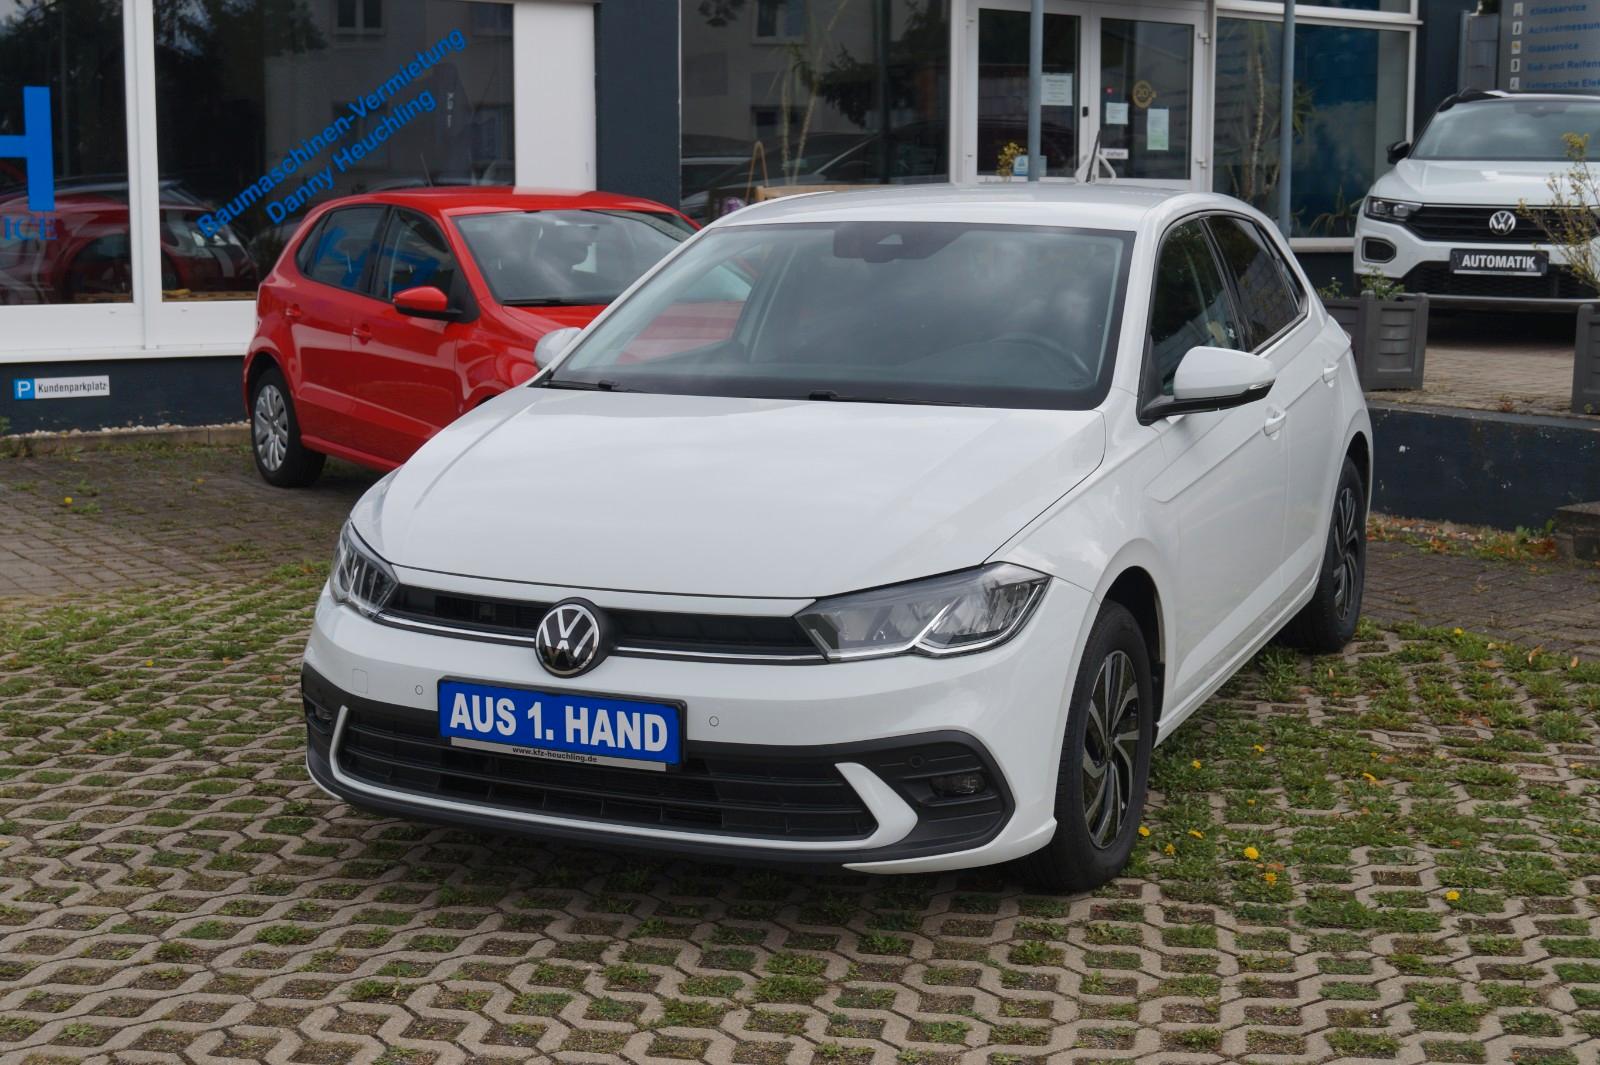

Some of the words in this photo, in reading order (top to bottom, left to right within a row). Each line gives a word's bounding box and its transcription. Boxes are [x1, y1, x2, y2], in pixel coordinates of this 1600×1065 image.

[1548, 62, 1565, 71] und
[195, 28, 467, 238] Baumaschinen-Vermietung
[265, 166, 336, 225] Danny
[332, 89, 437, 174] Heuchling
[1461, 253, 1536, 269] AUTOMATIK
[18, 381, 31, 398] P
[38, 381, 107, 393] Kundenparkplatz
[450, 692, 517, 736] AUS
[527, 701, 555, 741] 1.
[565, 706, 668, 752] HAND
[512, 746, 598, 763] www.kfz-heuchling.de
